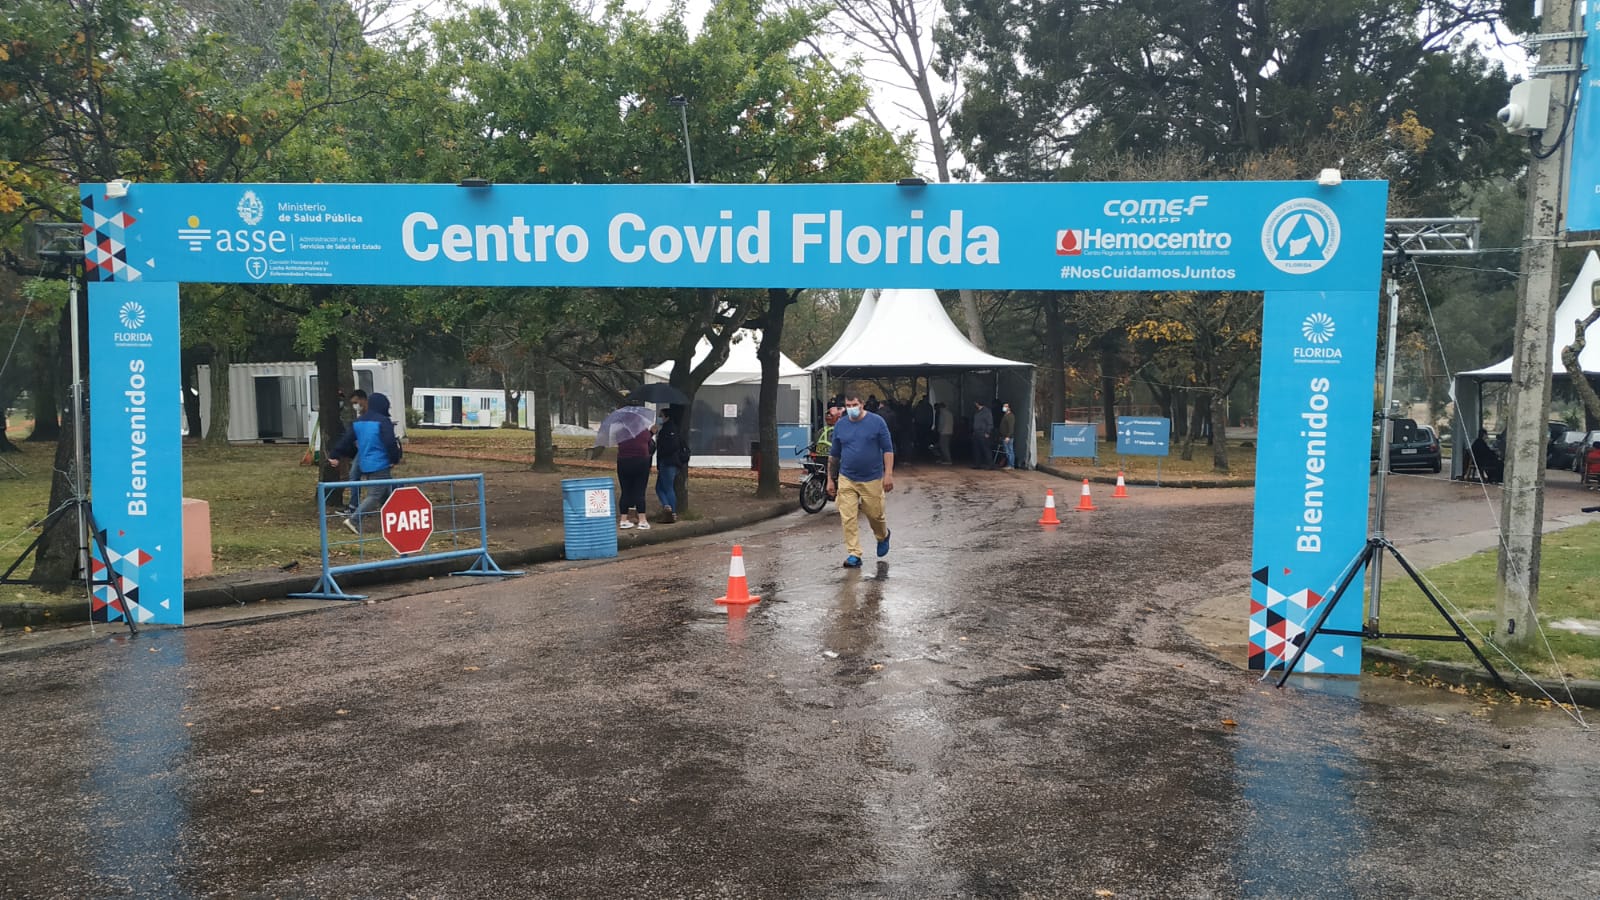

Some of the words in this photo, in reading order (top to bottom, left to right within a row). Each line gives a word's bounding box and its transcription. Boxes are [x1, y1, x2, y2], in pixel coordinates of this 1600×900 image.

[278, 202, 327, 212] Ministerio
[278, 213, 291, 222] de
[294, 213, 322, 222] Salud
[325, 213, 363, 223] Pública
[1121, 217, 1181, 225] IAMPP
[216, 229, 287, 253] asse
[401, 211, 590, 263] Centro
[608, 209, 771, 264] Covid
[792, 209, 1001, 265] Florida
[1084, 228, 1232, 250] Hemocentro
[1060, 265, 1236, 280] #NosCuidamosJuntos
[114, 332, 153, 342] FLORIDA
[1293, 347, 1343, 358] FLORIDA
[125, 359, 148, 516] Bienvenidos
[1295, 377, 1331, 553] Bienvenidos
[385, 508, 430, 534] PARE
